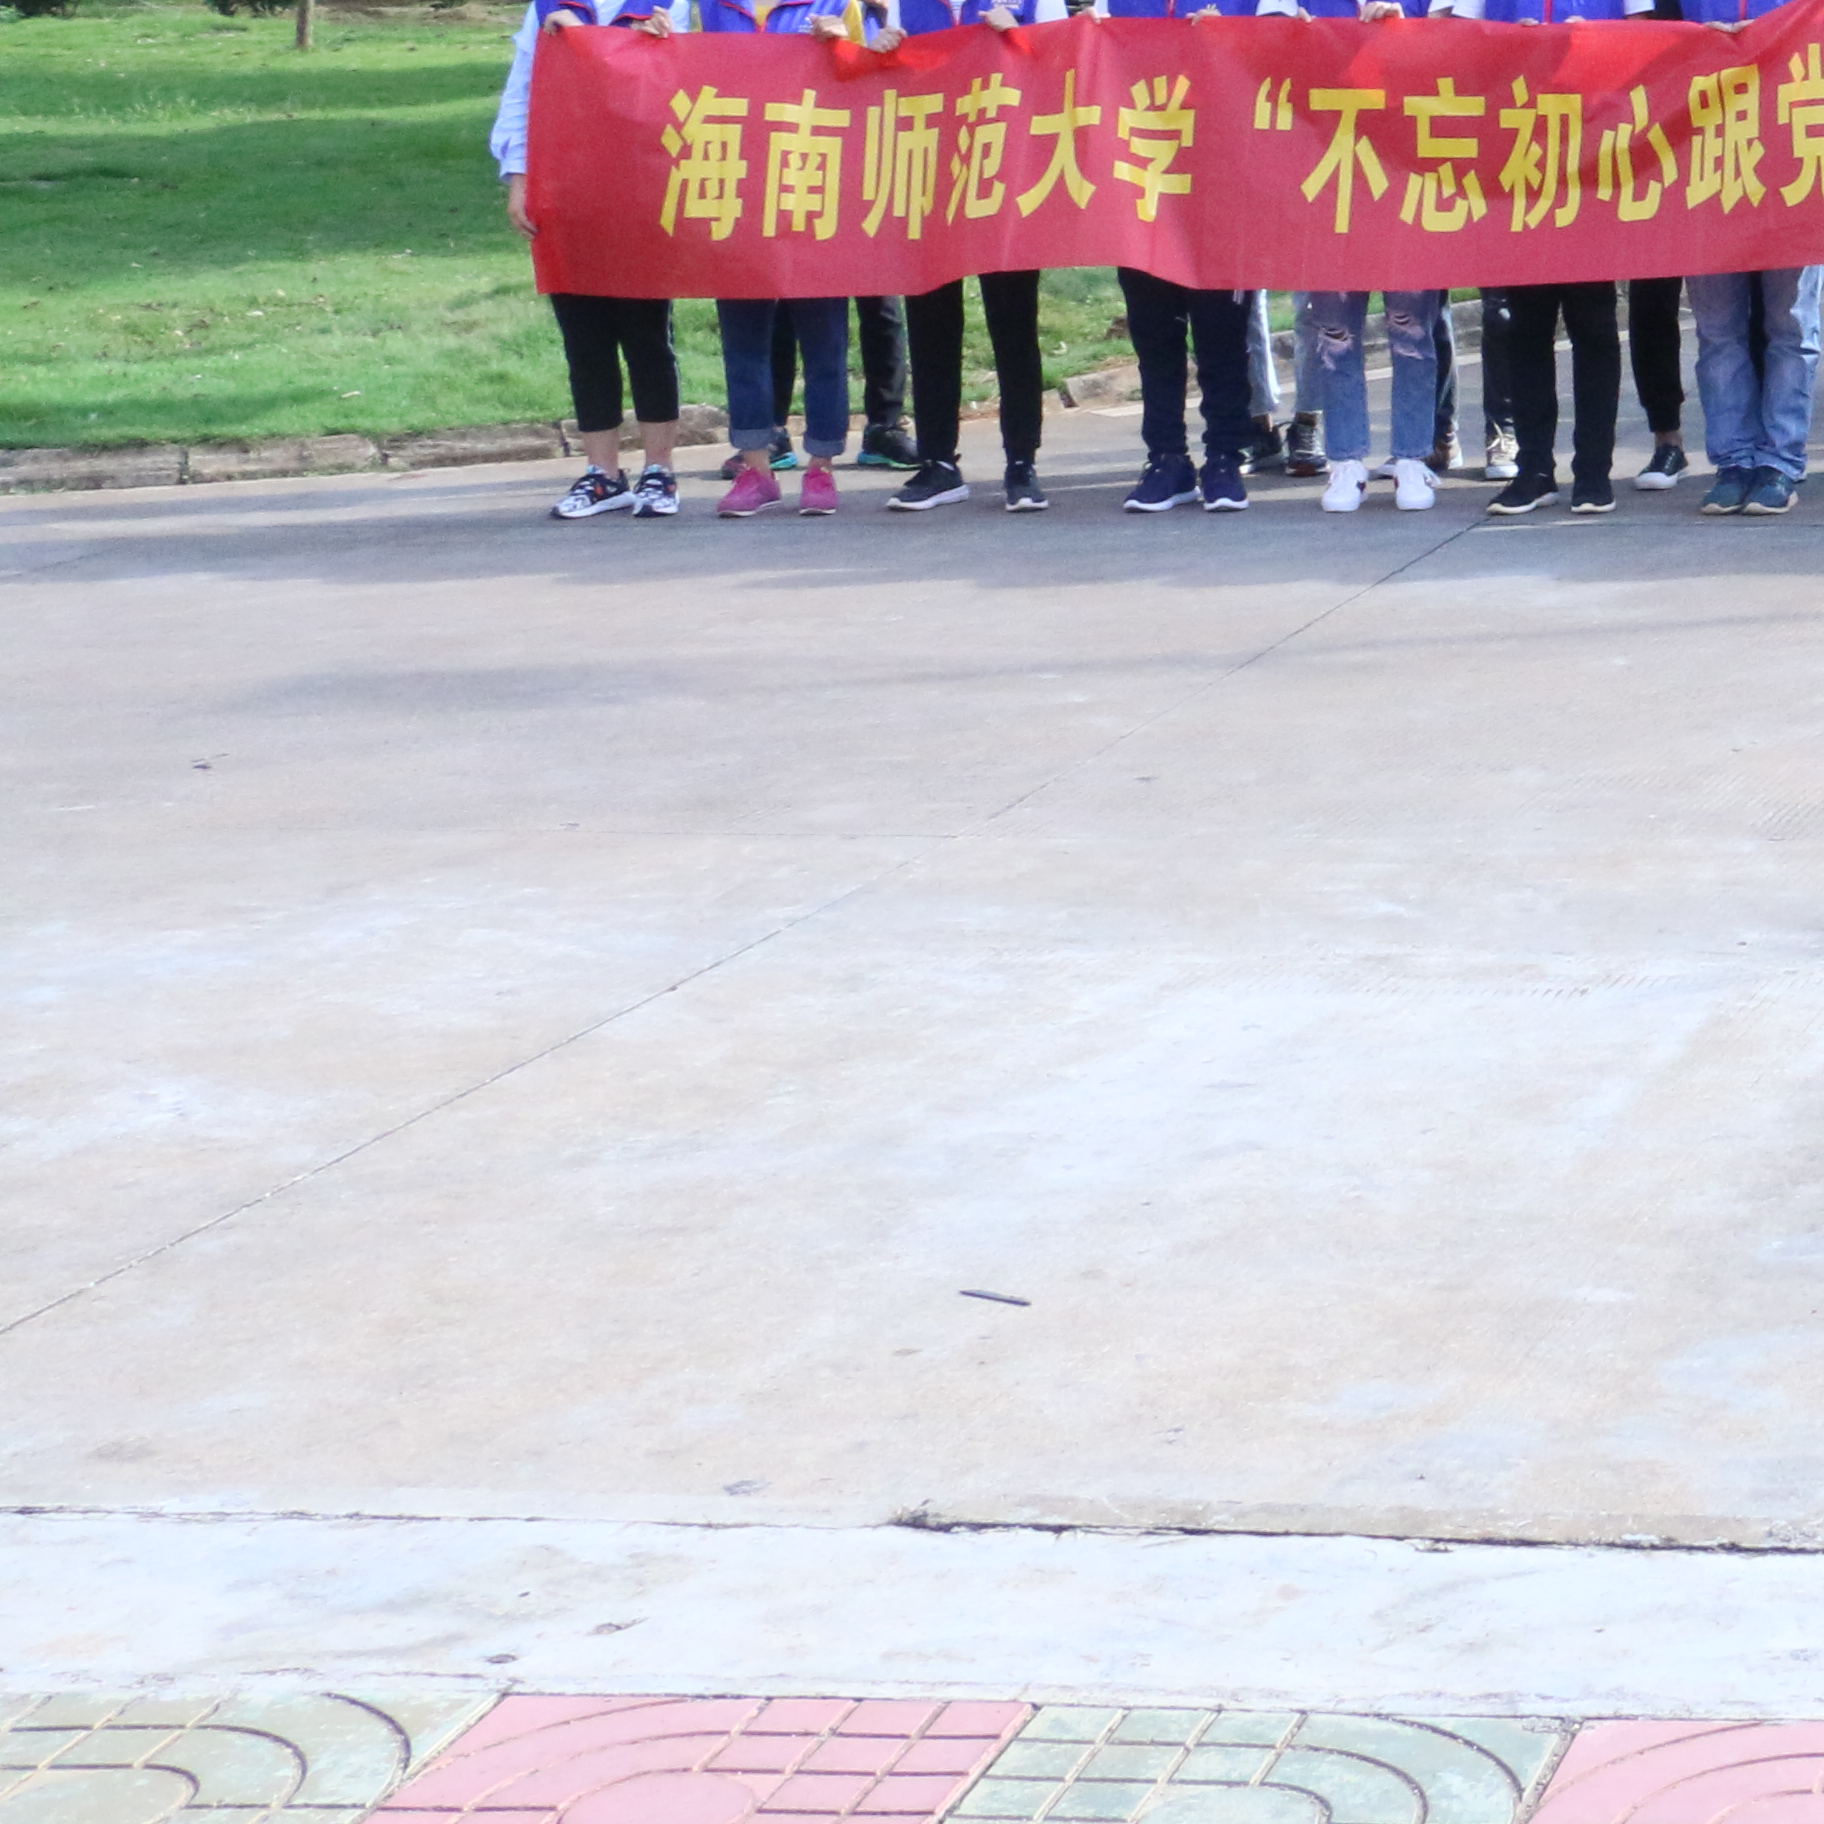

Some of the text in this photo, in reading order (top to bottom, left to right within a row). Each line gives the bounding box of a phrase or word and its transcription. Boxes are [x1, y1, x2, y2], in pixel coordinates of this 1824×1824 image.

[659, 69, 1195, 241] 海南师范大学
